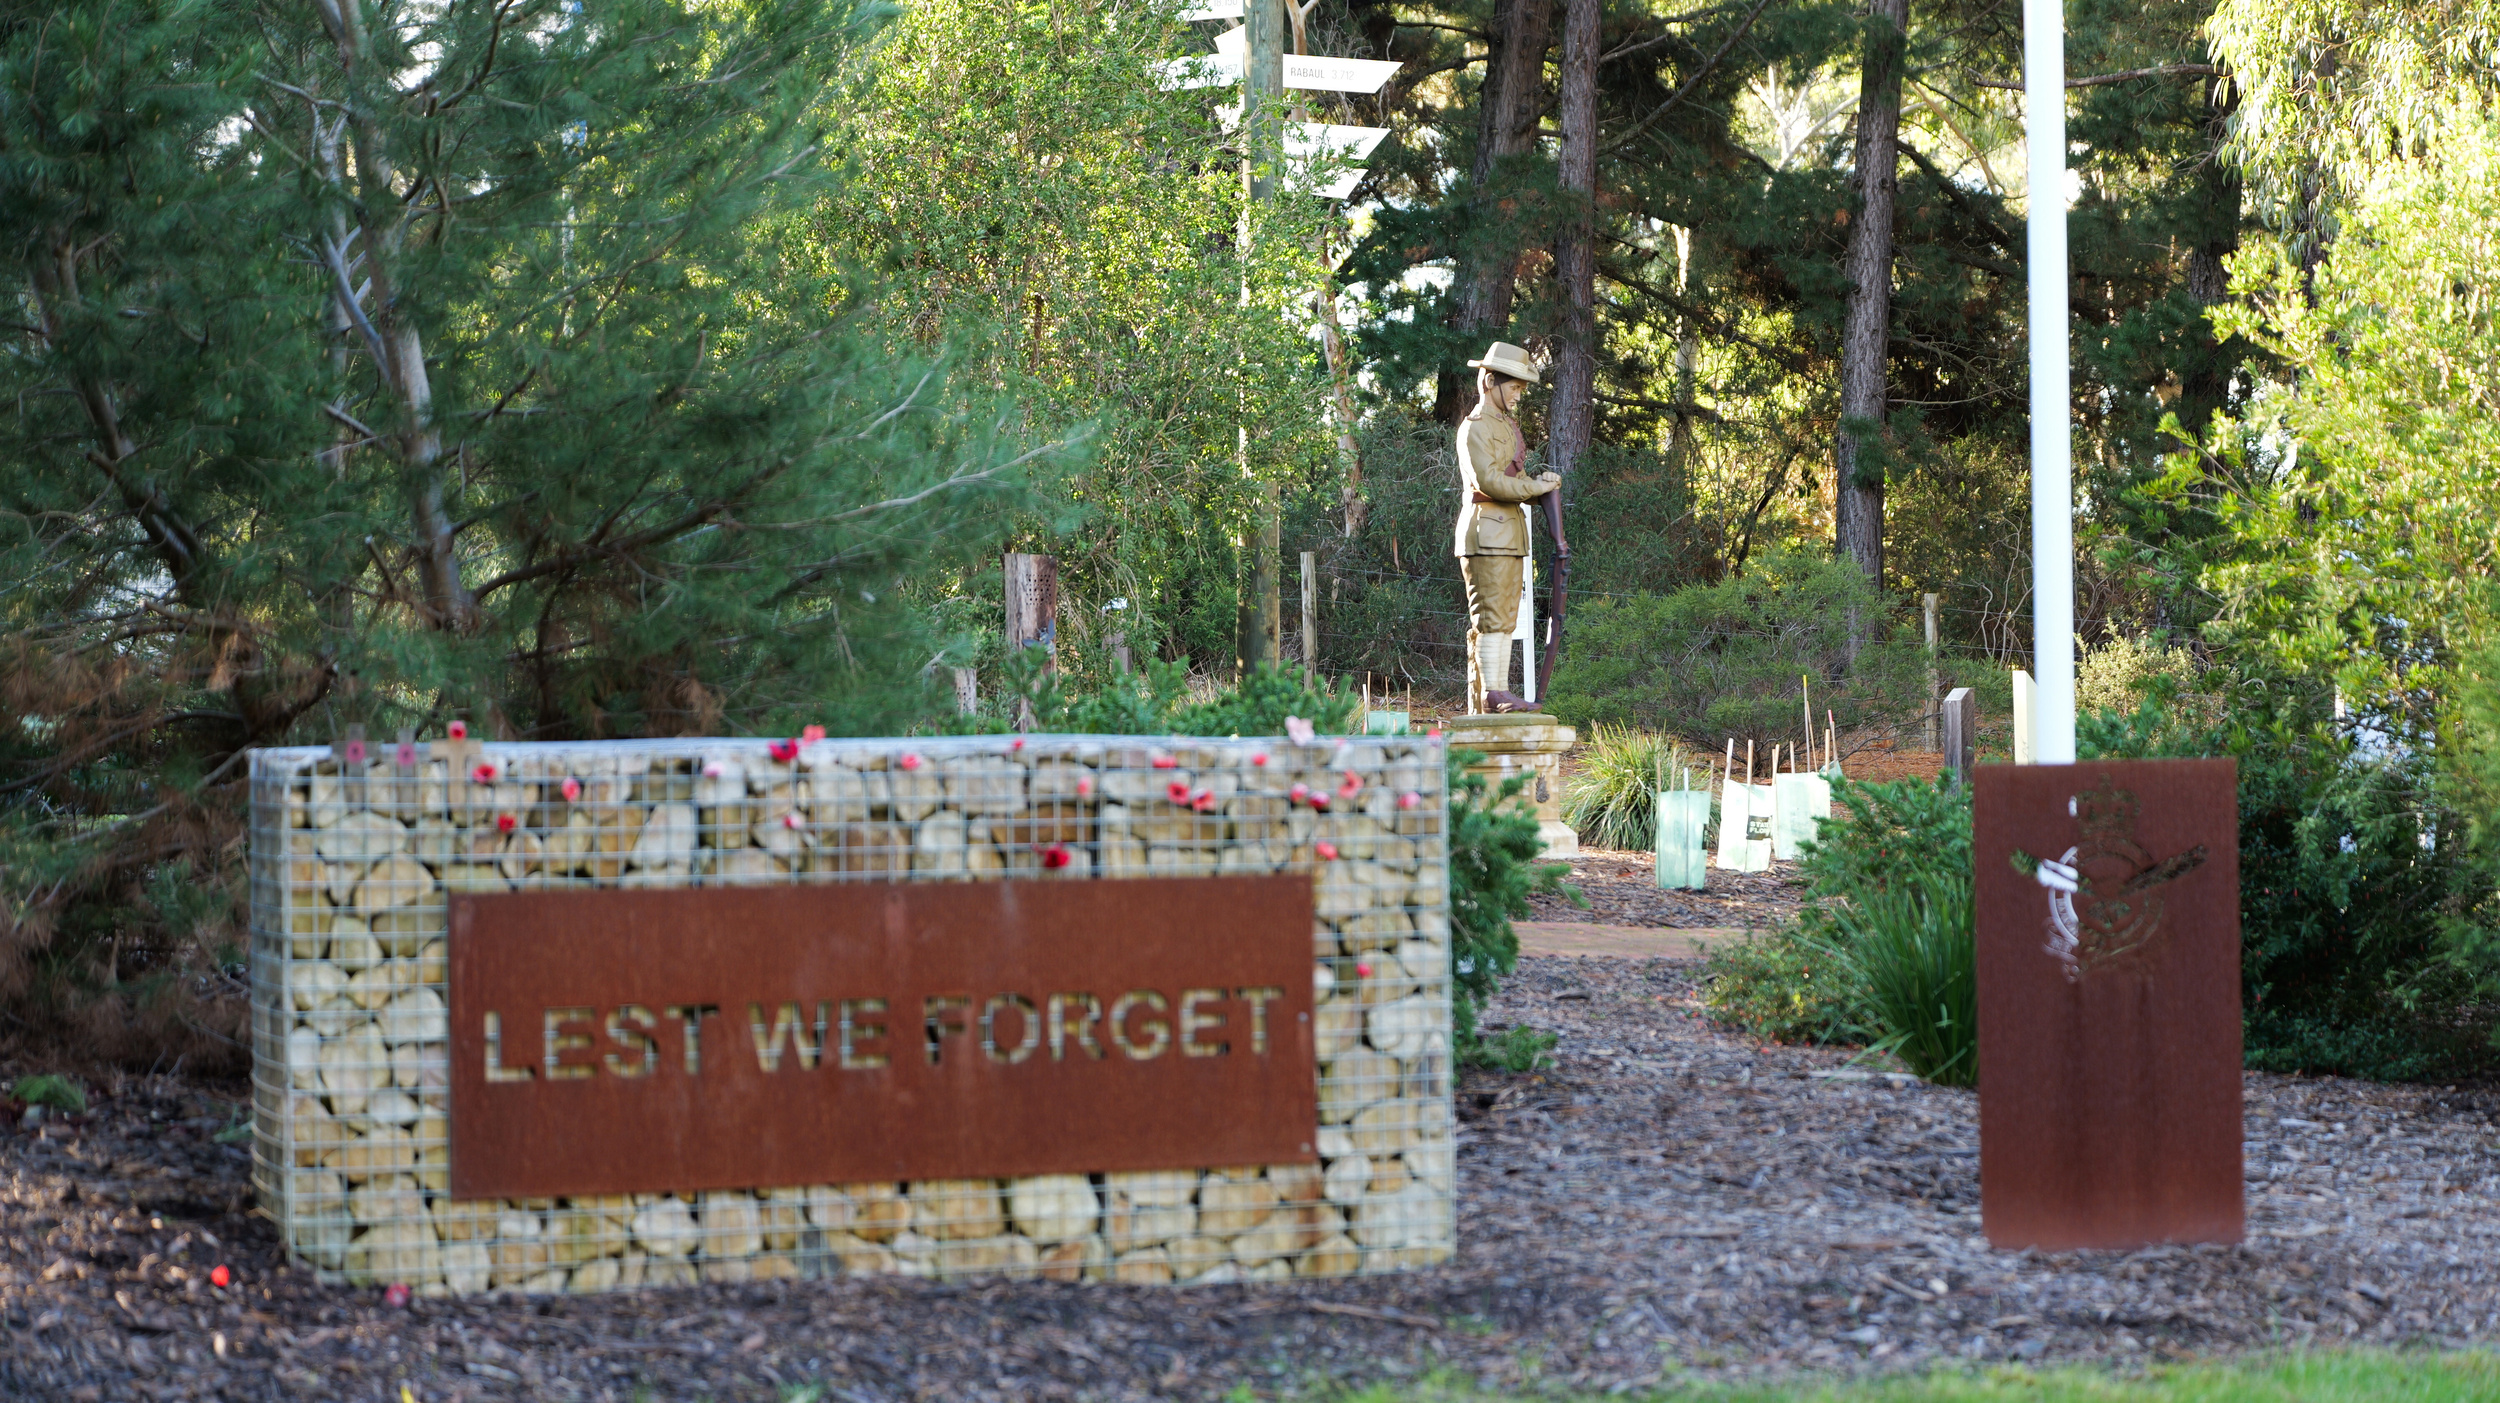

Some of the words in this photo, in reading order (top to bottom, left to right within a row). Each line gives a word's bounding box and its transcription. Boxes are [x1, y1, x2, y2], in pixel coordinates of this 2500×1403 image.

[1290, 66, 1326, 79] RABAUL
[482, 1005, 721, 1084] LEST
[747, 997, 890, 1073] WE
[922, 986, 1286, 1066] FORGET
